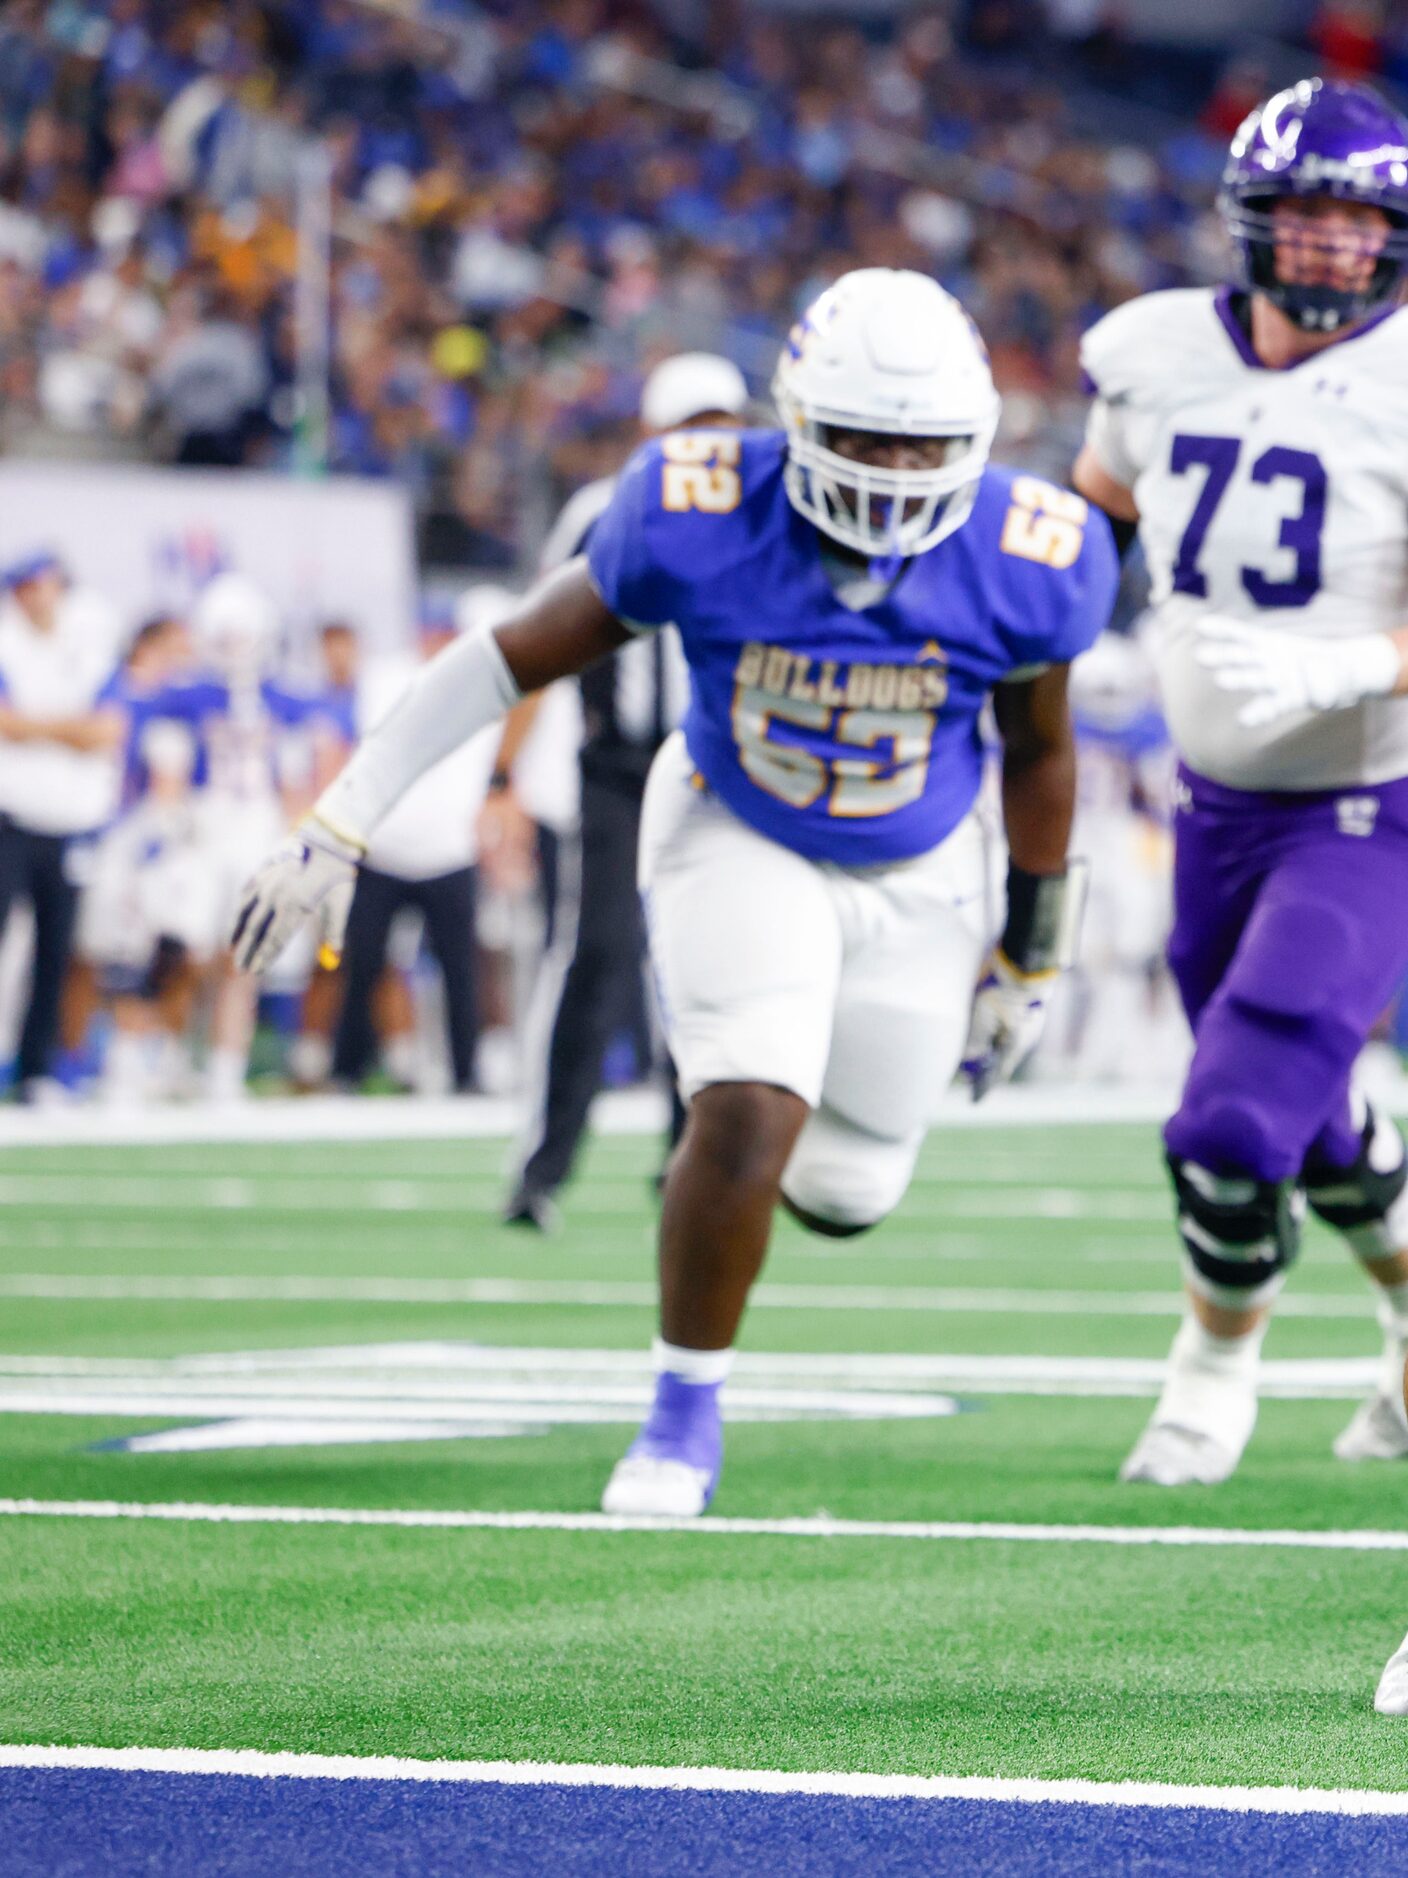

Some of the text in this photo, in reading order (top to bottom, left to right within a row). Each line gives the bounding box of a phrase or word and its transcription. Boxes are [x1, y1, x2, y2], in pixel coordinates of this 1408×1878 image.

[662, 431, 742, 514] 52
[1000, 475, 1089, 569] 52
[1170, 434, 1328, 608] 73
[734, 640, 949, 711] BULLDOGS
[730, 680, 939, 819] 52
